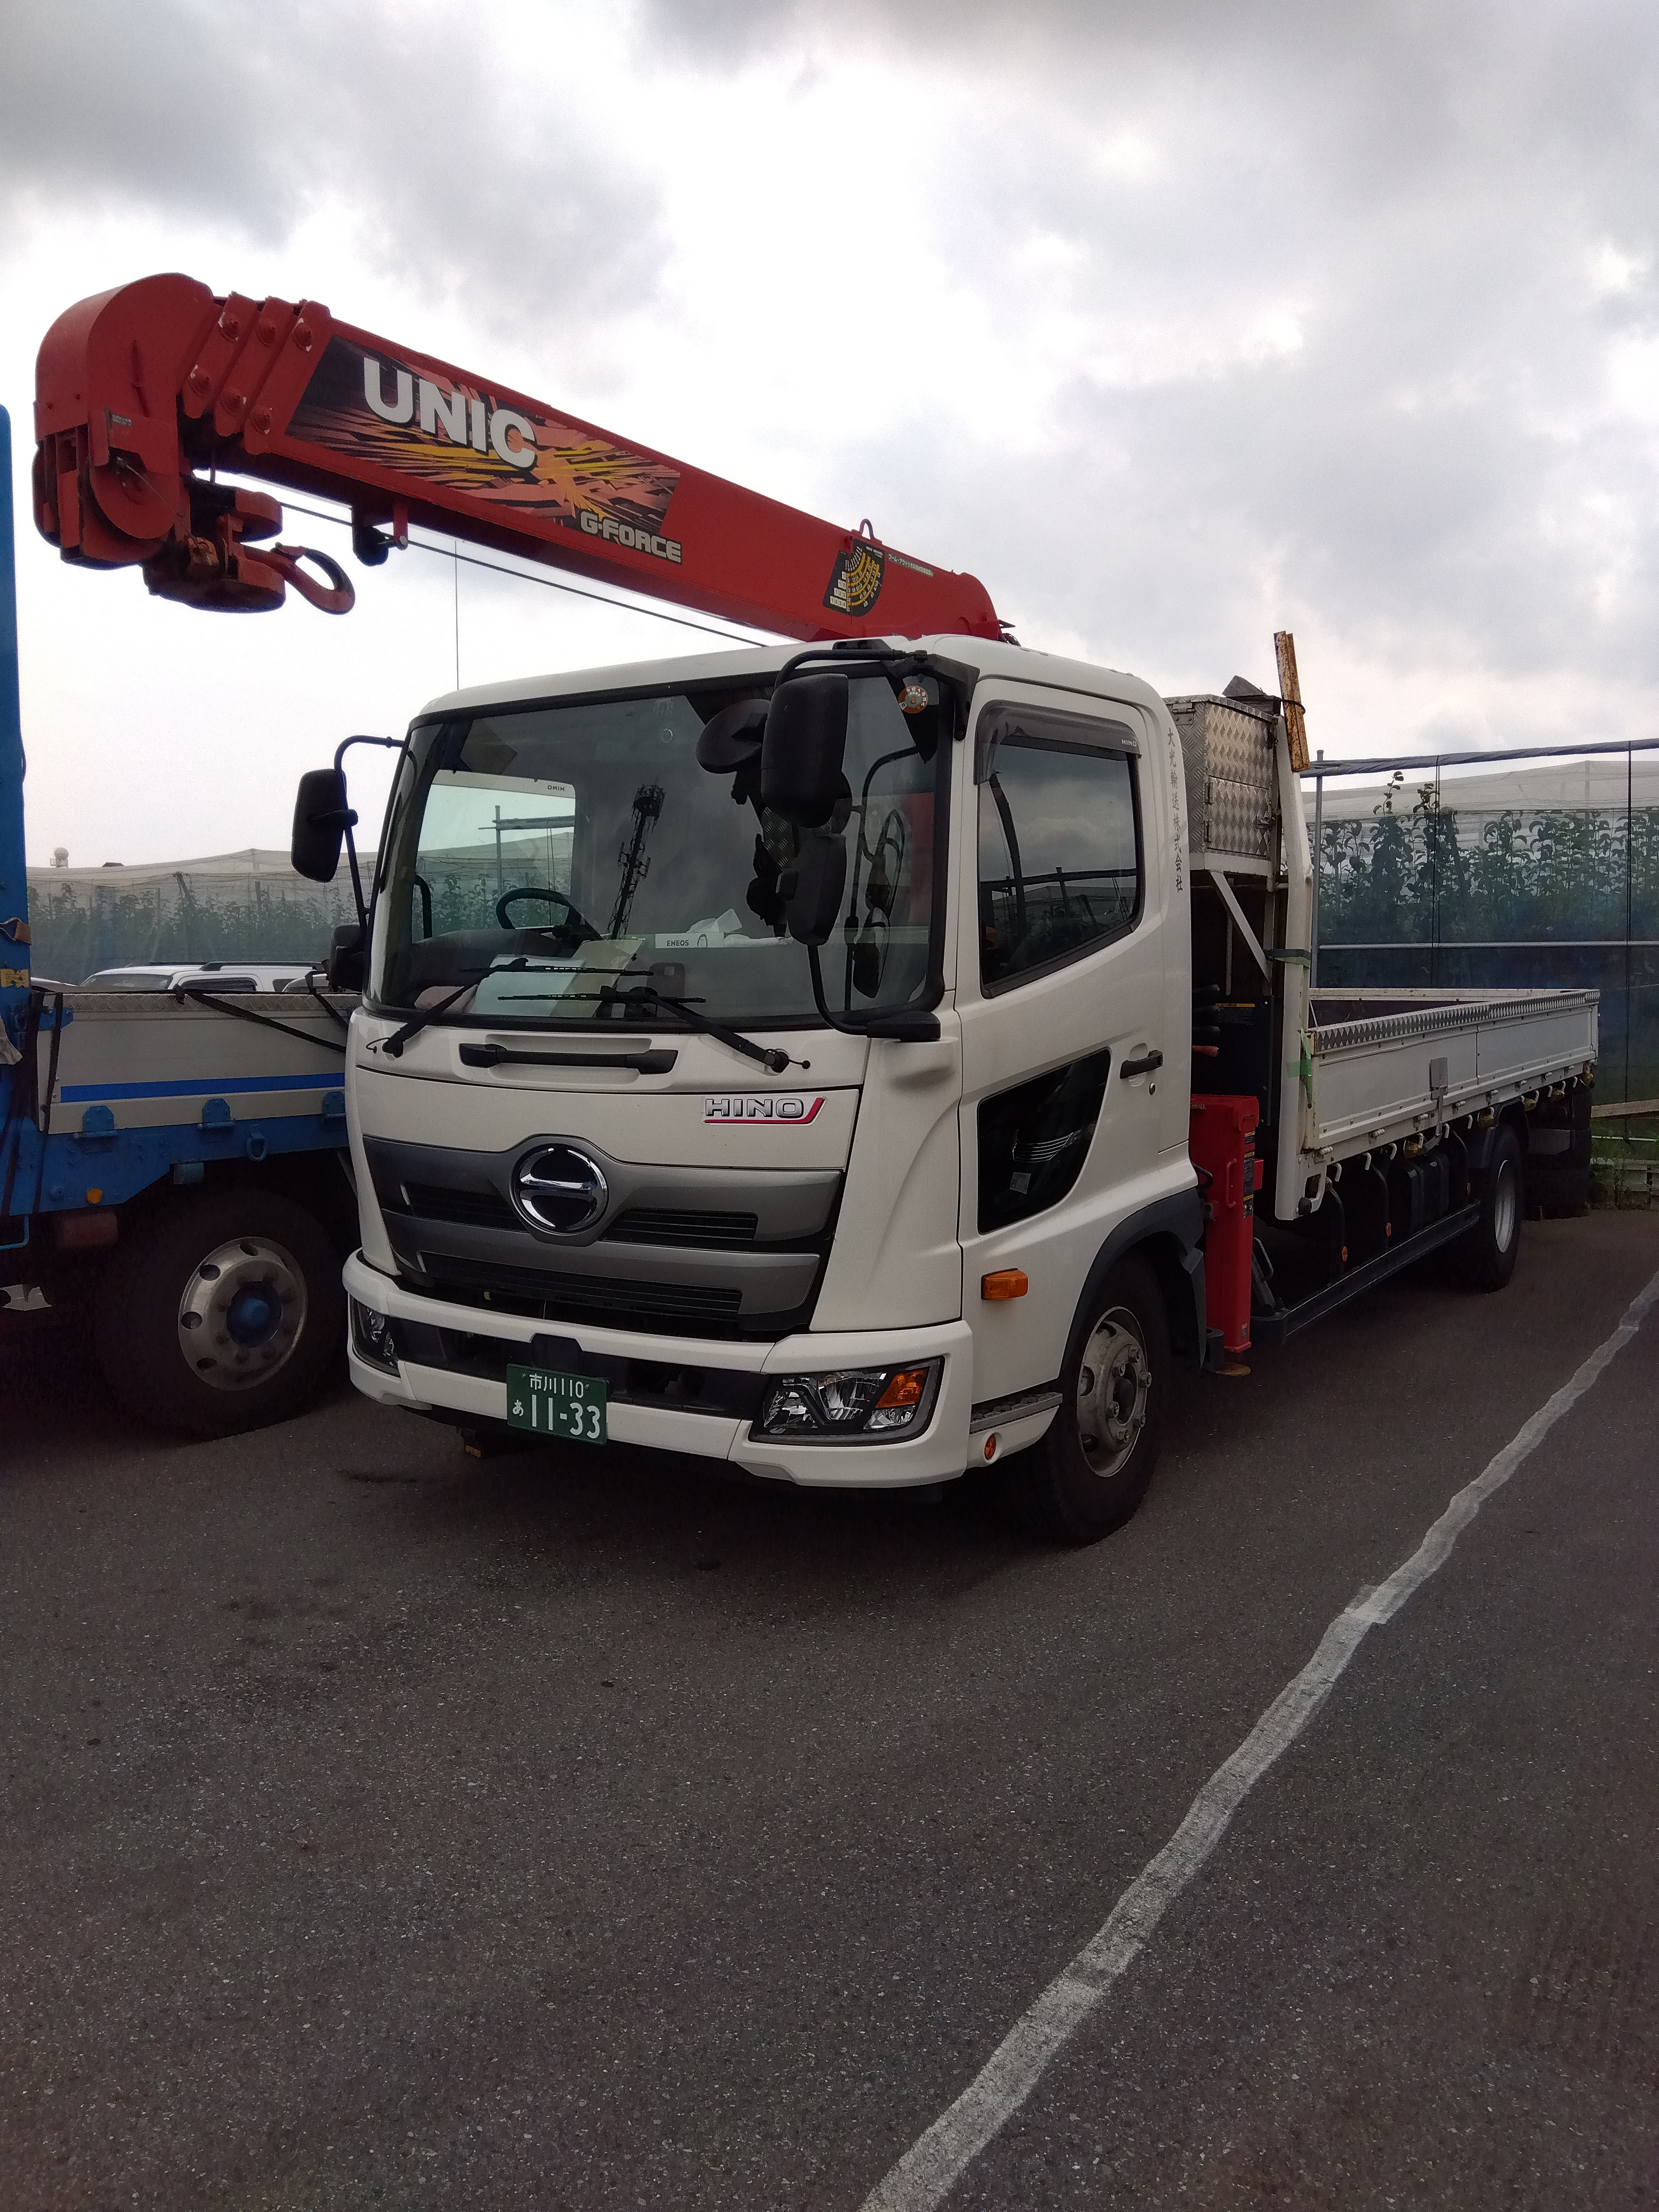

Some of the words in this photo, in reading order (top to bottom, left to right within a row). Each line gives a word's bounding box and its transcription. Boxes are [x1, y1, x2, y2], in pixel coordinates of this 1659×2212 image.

[364, 357, 535, 468] UNIC
[1121, 739, 1137, 747] HINO
[1168, 727, 1183, 893] 大光輸送株式会社
[706, 1099, 805, 1118] HINO
[512, 1399, 524, 1417] あ
[532, 1394, 600, 1439] 11-33
